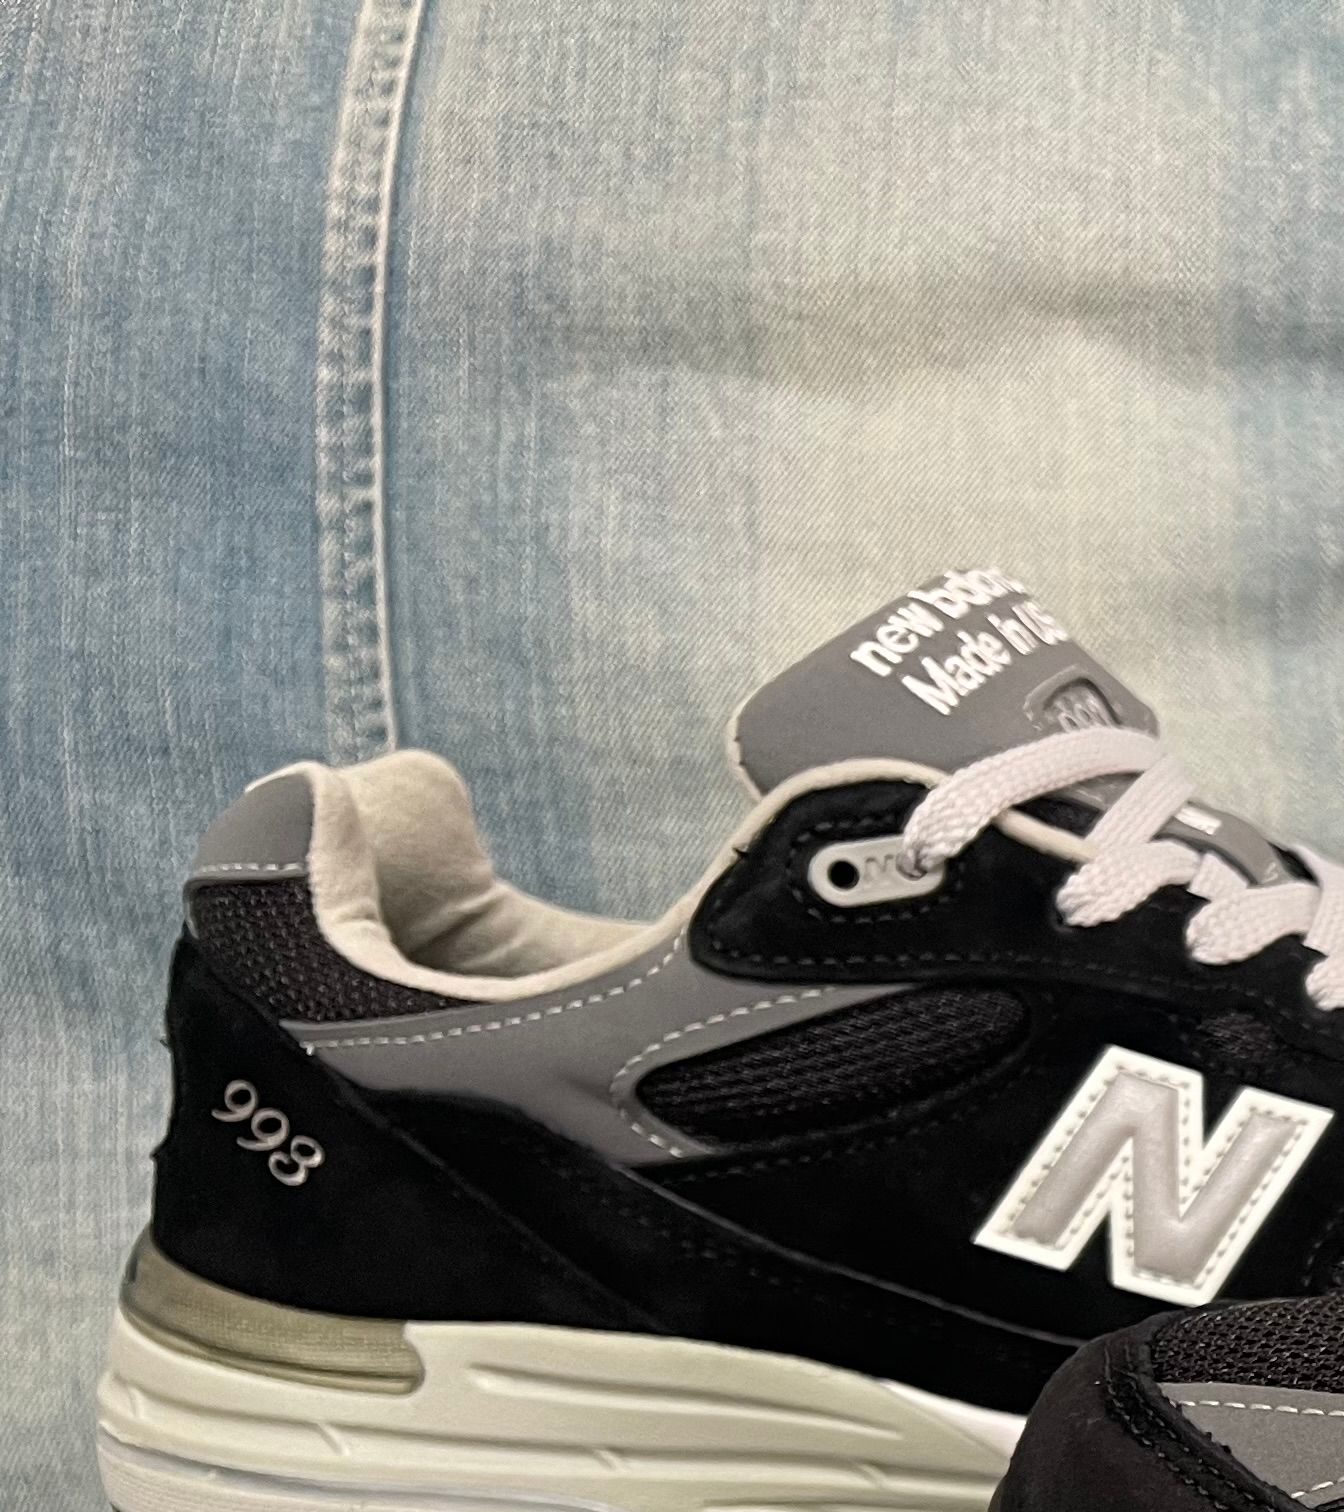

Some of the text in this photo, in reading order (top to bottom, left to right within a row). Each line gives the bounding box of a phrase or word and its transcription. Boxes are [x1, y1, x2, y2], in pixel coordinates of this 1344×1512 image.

[850, 602, 944, 677] new
[901, 630, 1012, 715] Made
[985, 613, 1040, 656] in
[211, 1079, 325, 1187] 993
[972, 1044, 1336, 1308] N
